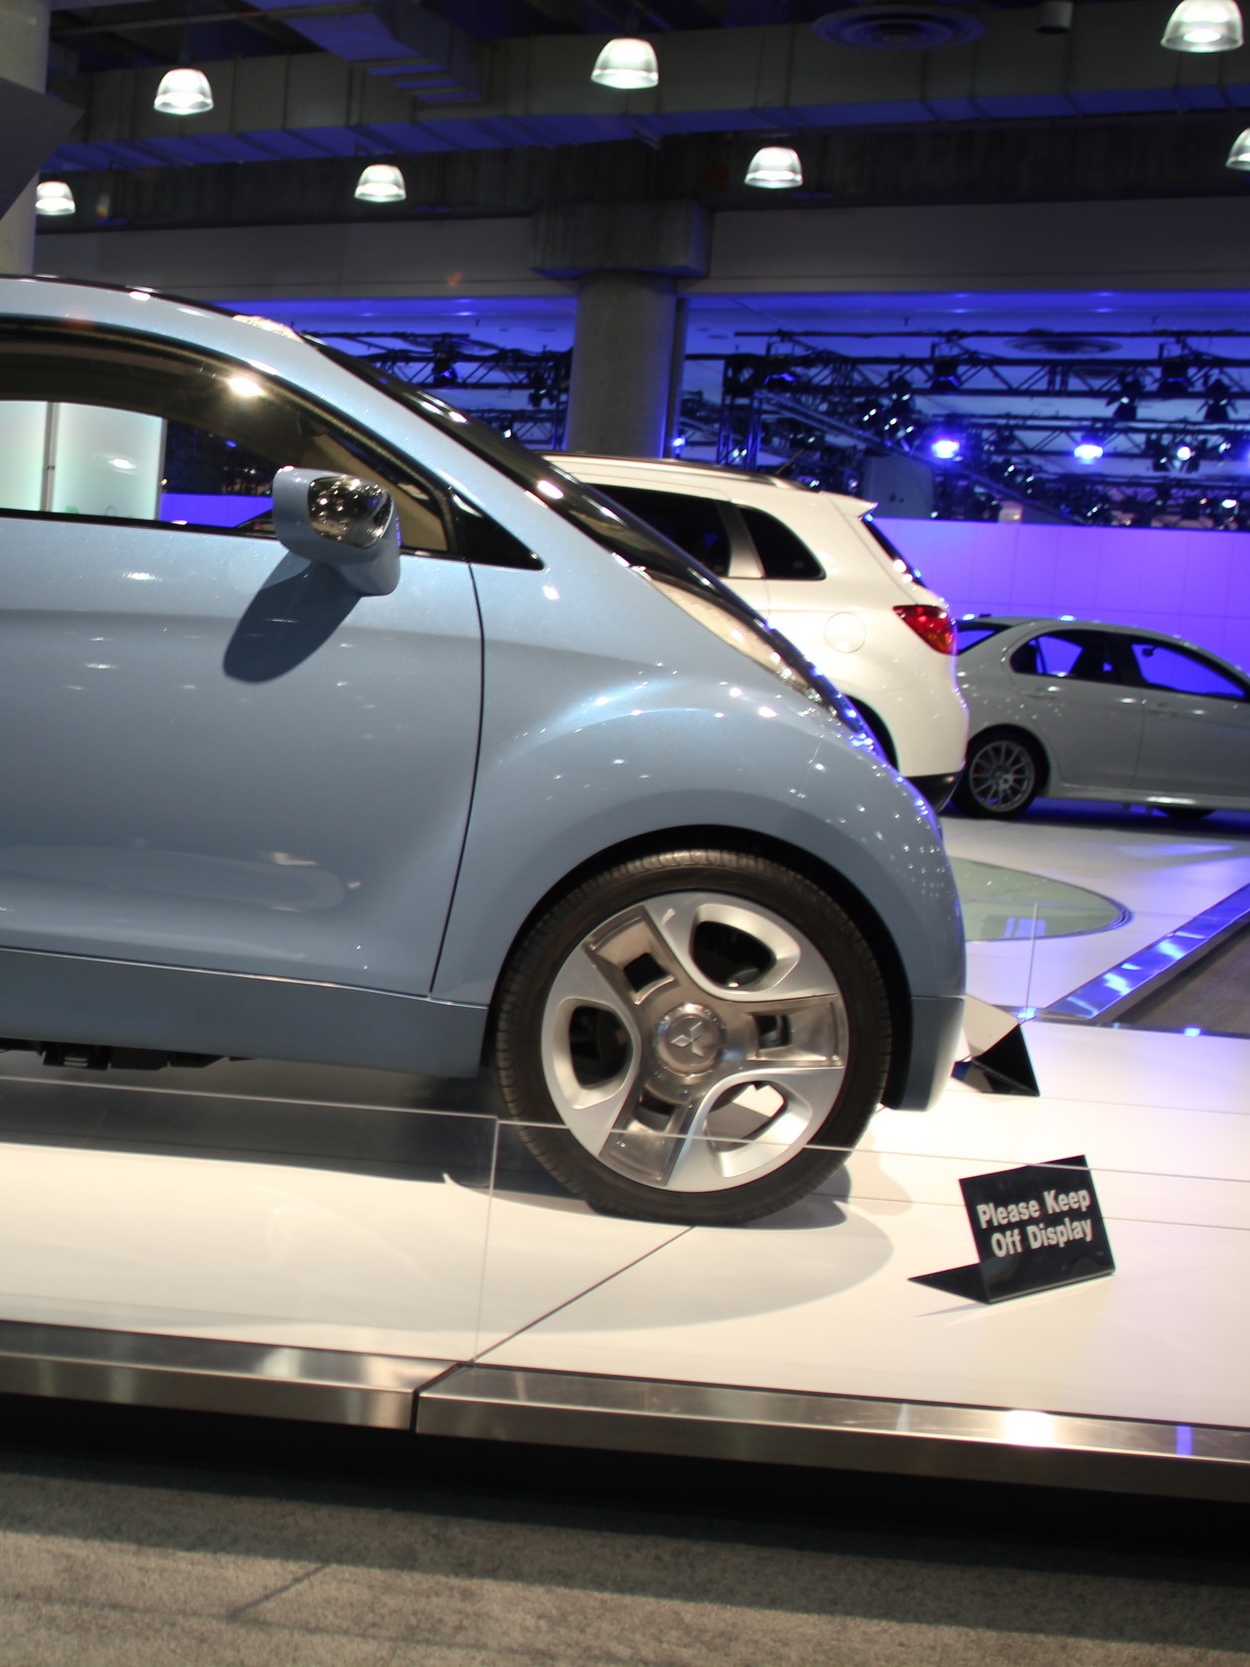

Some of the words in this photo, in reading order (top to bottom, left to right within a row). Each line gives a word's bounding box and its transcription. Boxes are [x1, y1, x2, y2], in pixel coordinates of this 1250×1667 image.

[976, 1200, 1041, 1229] Please
[1043, 1189, 1091, 1215] Keep
[991, 1228, 1022, 1258] Off
[1026, 1217, 1093, 1250] Display
